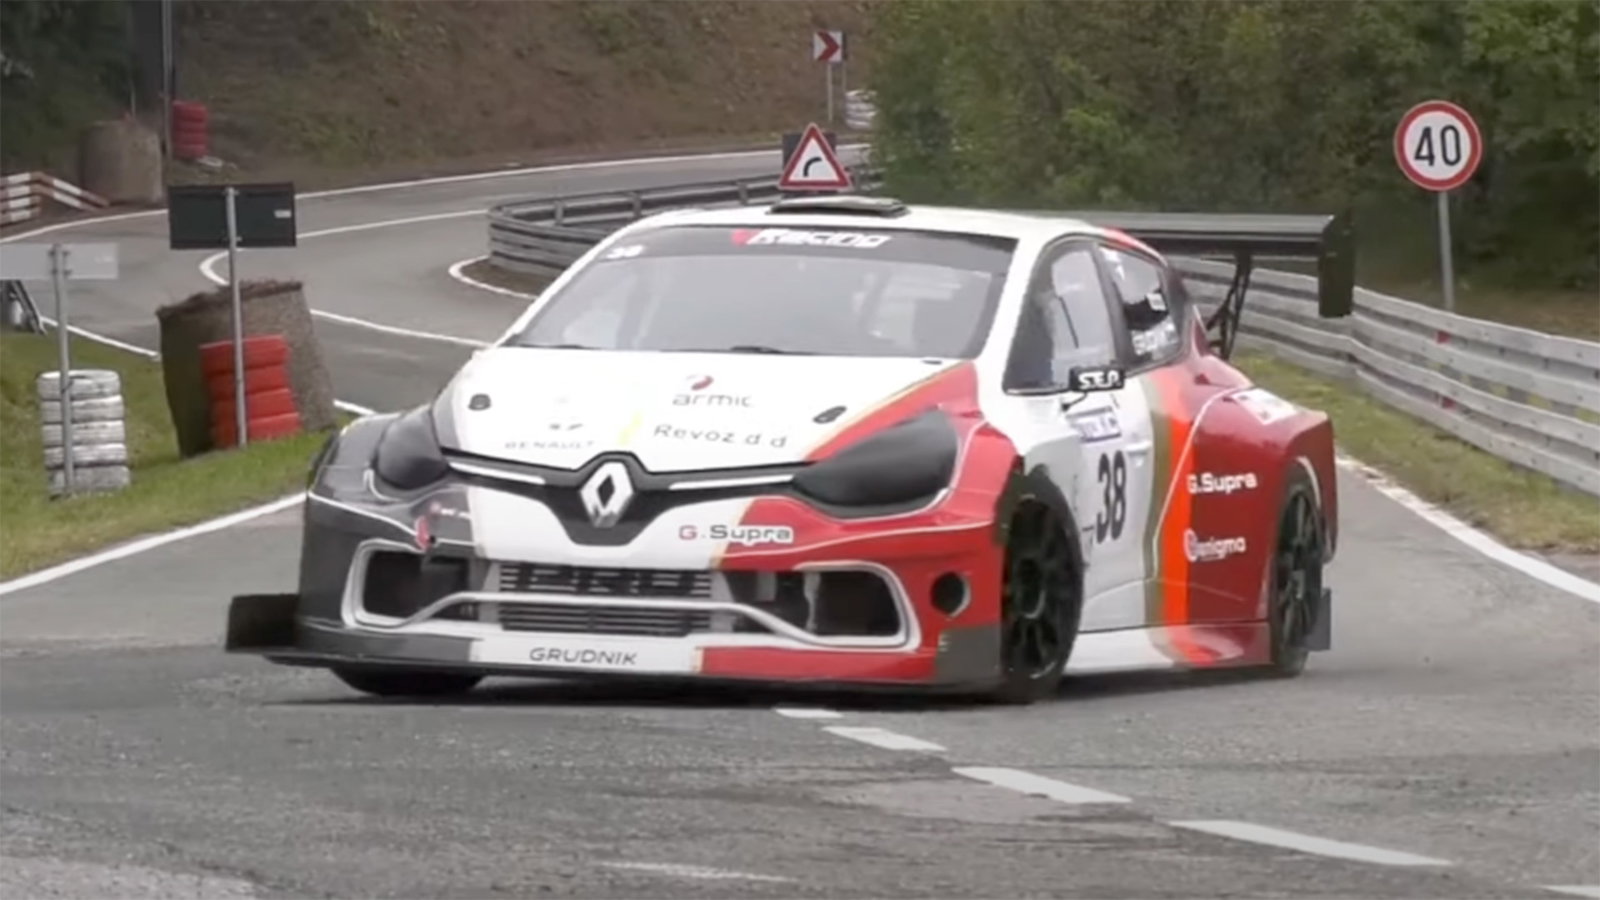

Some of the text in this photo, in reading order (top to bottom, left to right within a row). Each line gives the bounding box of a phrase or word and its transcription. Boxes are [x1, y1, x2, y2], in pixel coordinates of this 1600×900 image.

[1414, 125, 1461, 167] 40
[672, 394, 755, 408] armic
[654, 424, 735, 444] Revoz
[1187, 472, 1258, 495] G.Supra
[1097, 450, 1126, 544] 38
[529, 646, 638, 666] GRUDNIK
